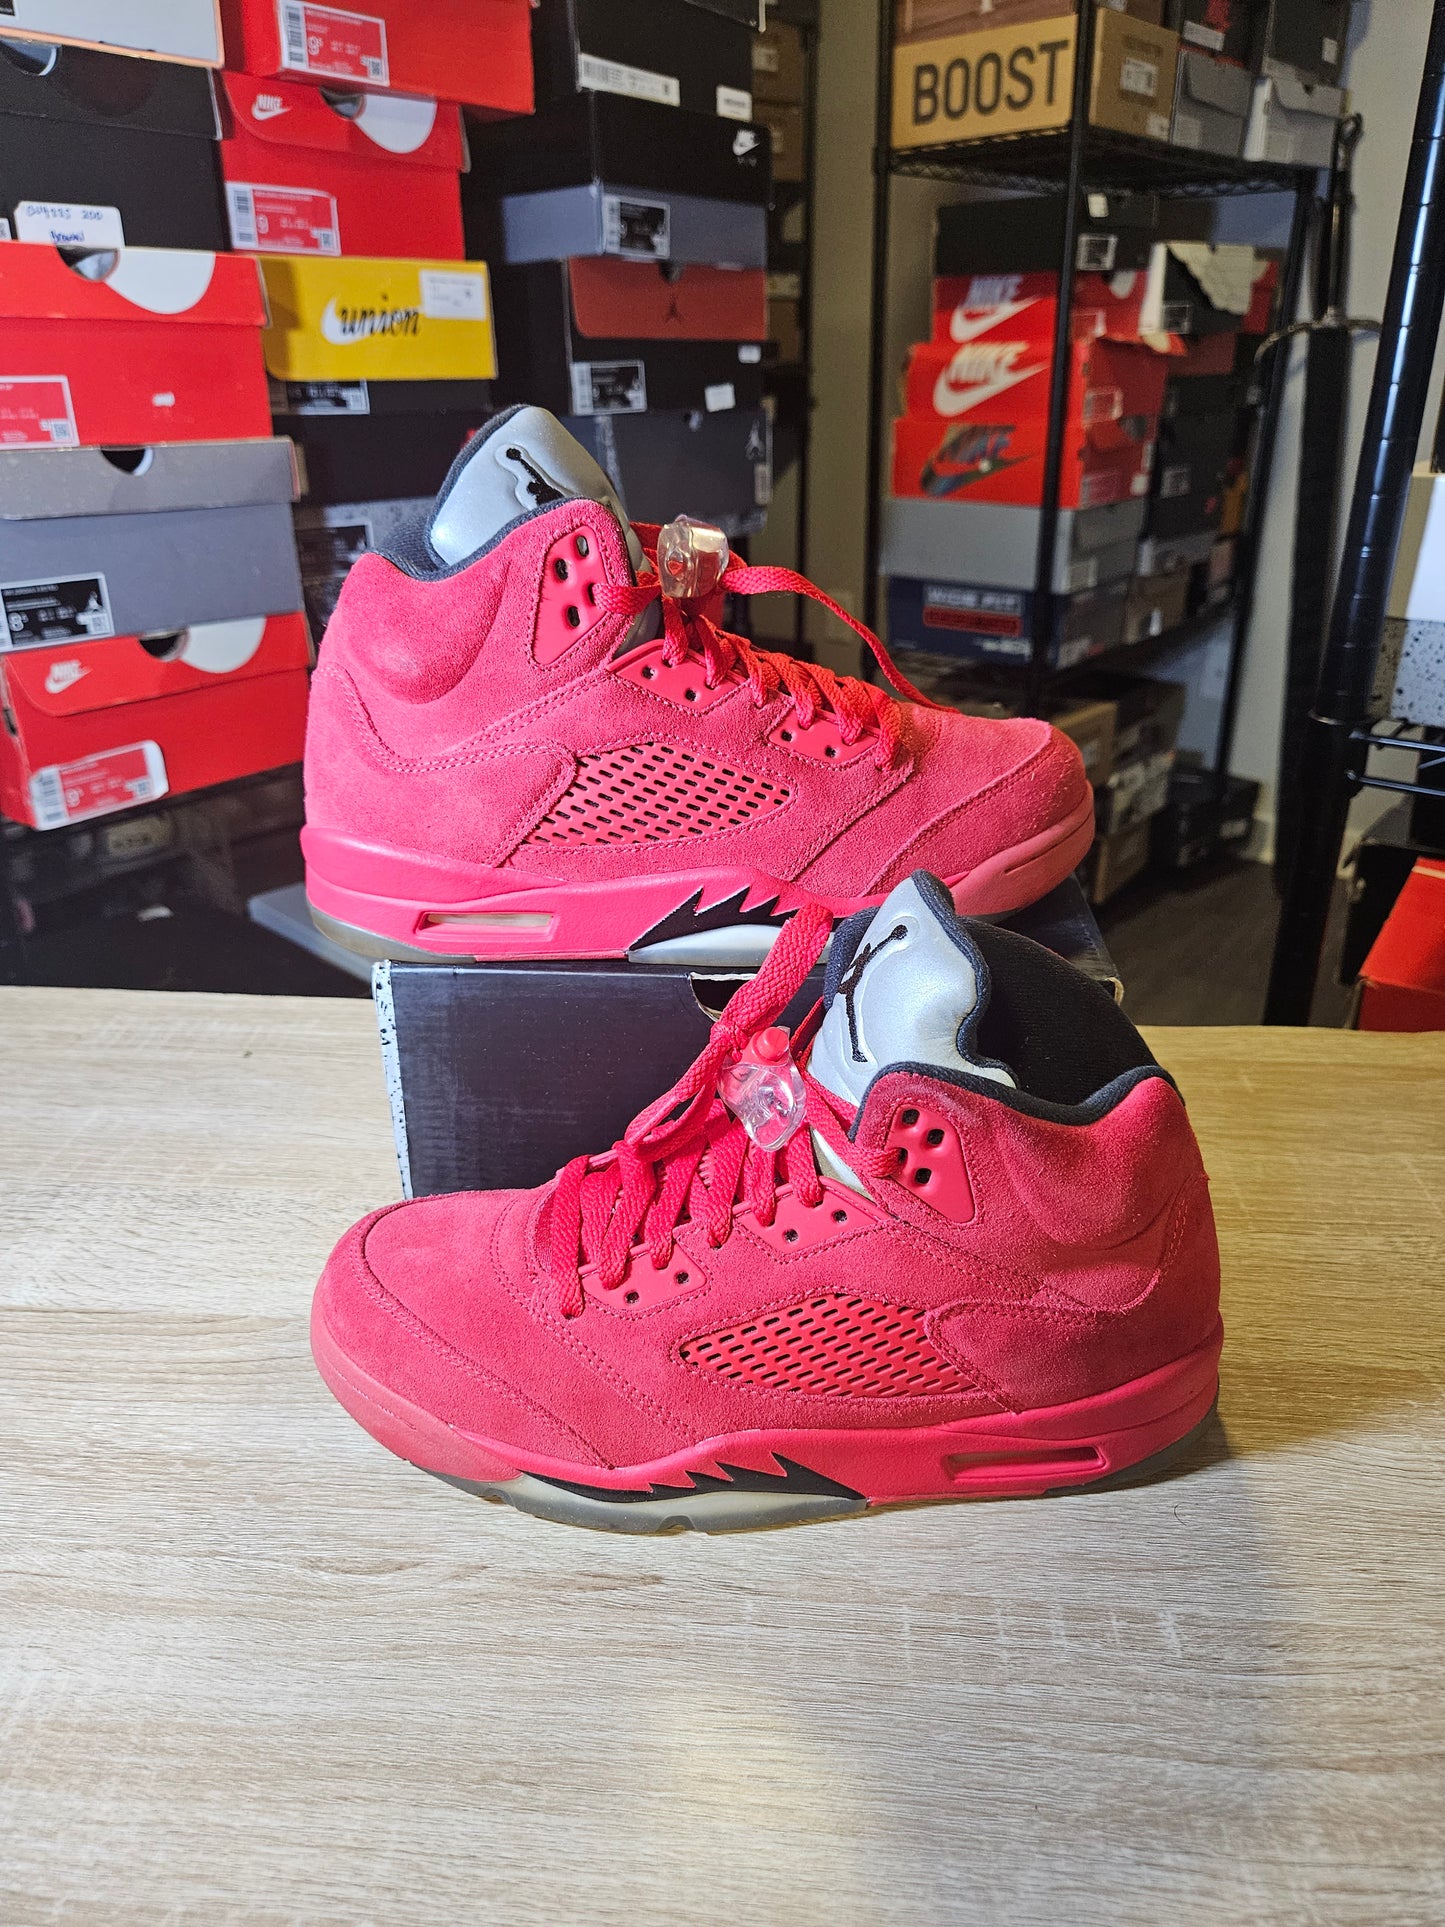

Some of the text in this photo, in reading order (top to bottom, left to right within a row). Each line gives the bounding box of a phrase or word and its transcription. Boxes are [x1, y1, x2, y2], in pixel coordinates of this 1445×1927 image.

[256, 94, 283, 110] NIKE
[914, 39, 1069, 125] BOOST
[962, 275, 1024, 311] NIKE
[340, 293, 420, 337] union
[949, 341, 1030, 383] NIKE
